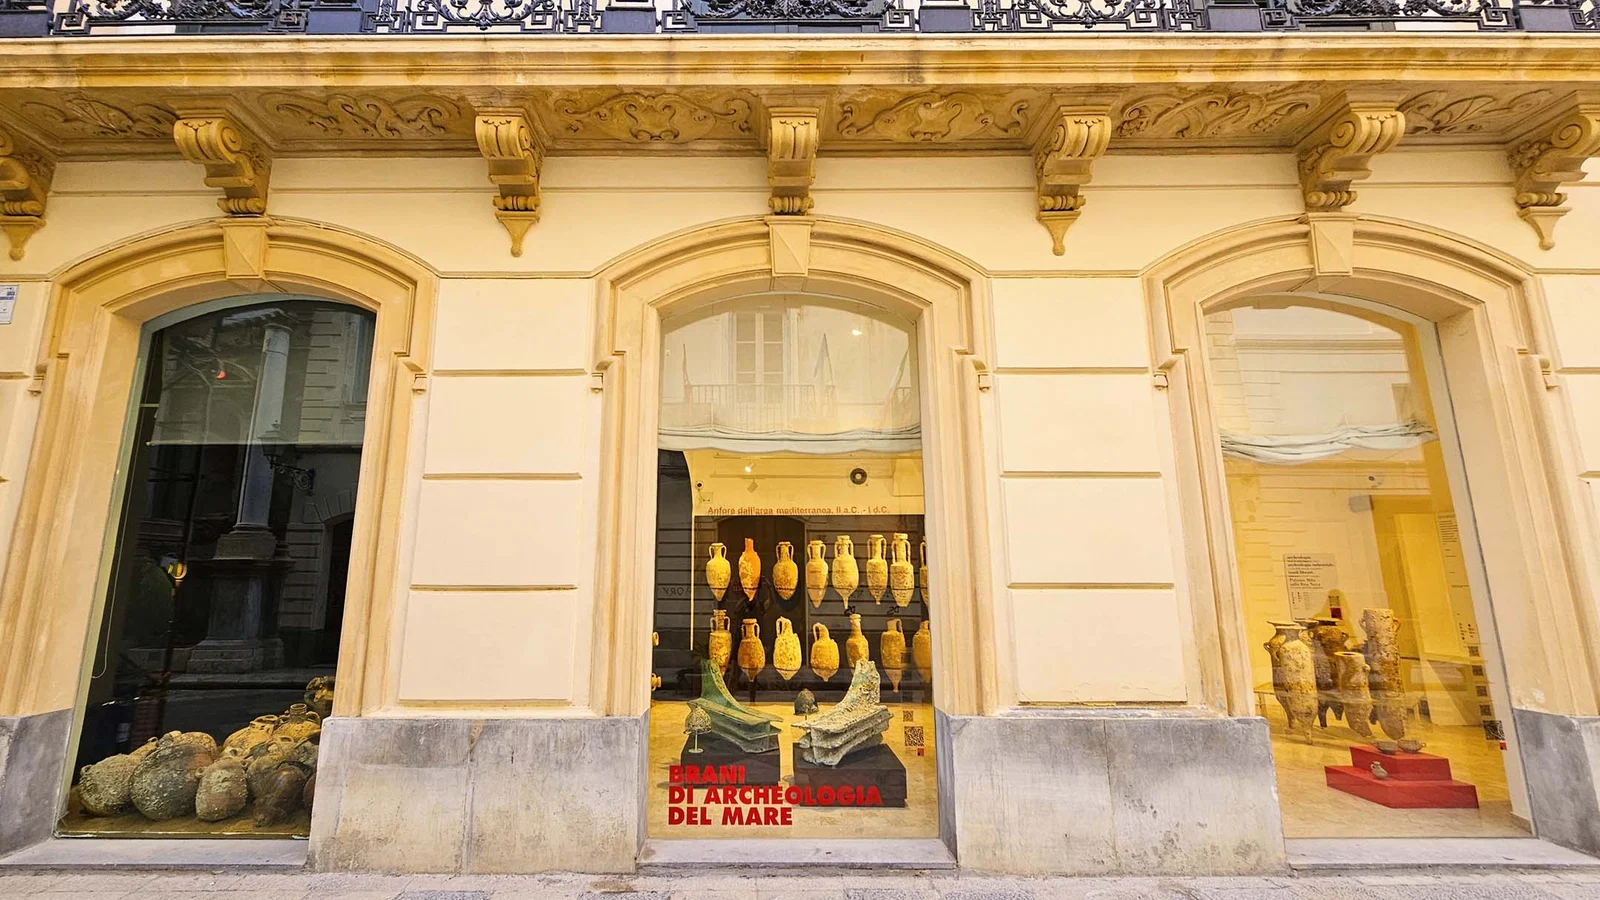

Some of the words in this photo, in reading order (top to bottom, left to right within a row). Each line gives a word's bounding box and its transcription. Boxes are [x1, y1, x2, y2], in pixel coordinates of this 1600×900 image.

[707, 506, 736, 515] Anfore
[669, 765, 745, 784] BRANI
[669, 785, 694, 804] DI
[703, 785, 883, 806] ARCHEOLOGIA
[668, 806, 711, 826] DEL
[721, 807, 792, 826] MARE
